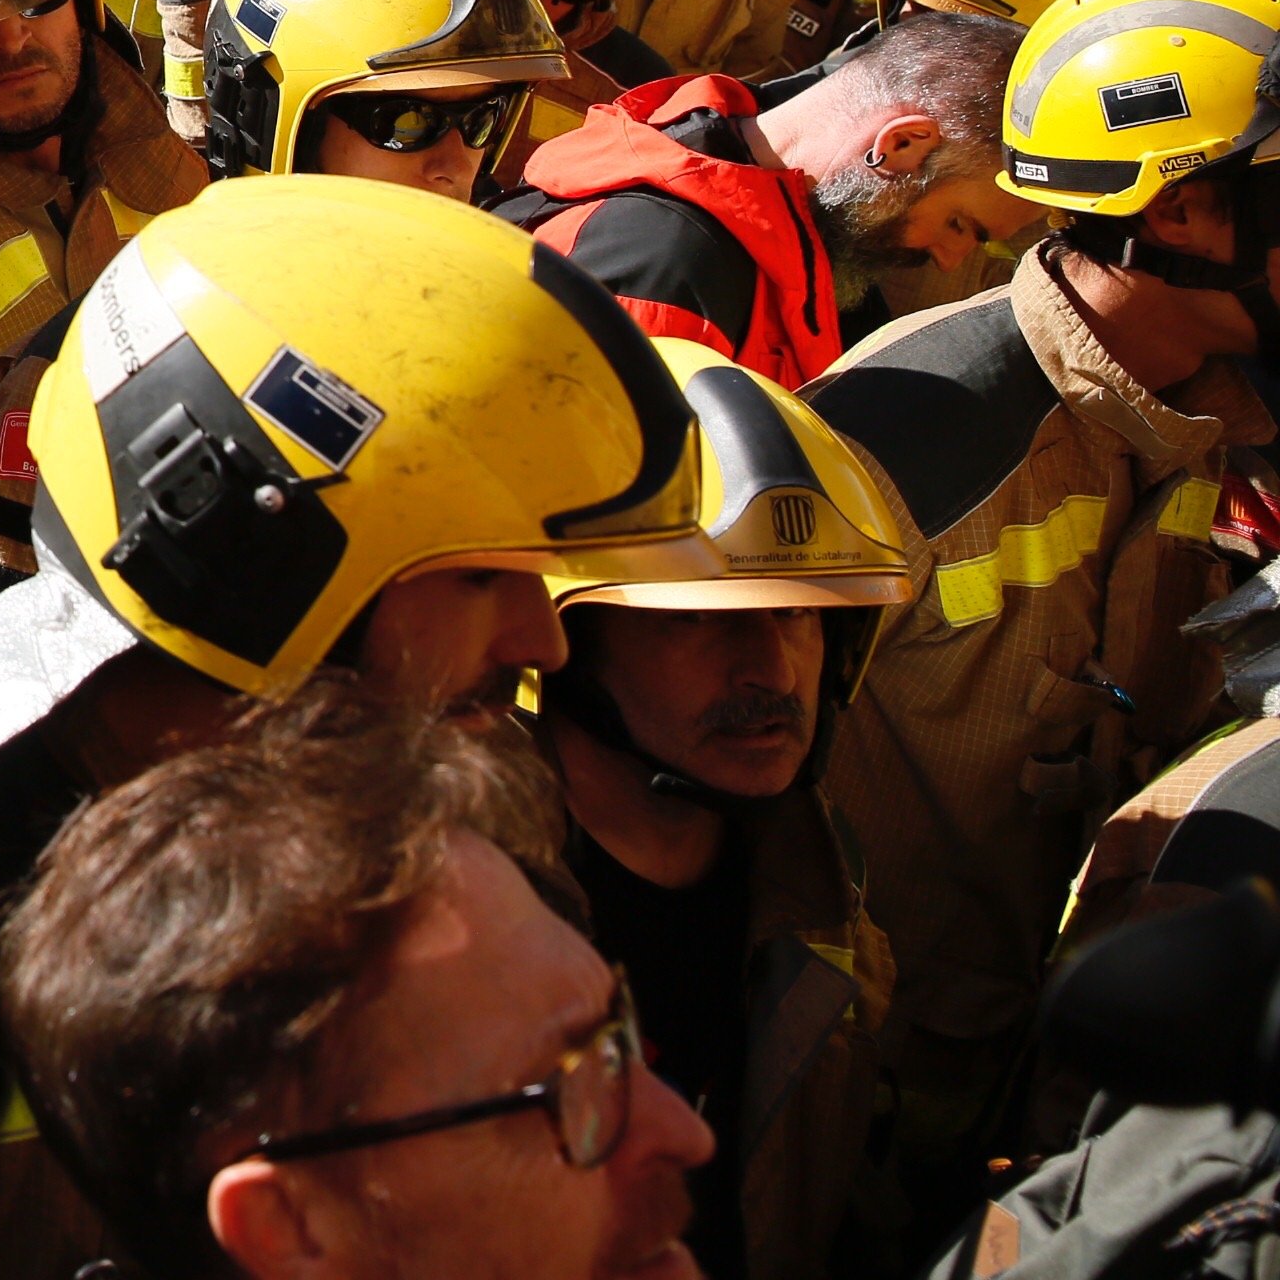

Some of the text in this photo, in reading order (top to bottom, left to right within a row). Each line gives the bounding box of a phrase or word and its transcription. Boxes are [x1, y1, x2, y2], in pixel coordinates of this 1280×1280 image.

[1131, 82, 1160, 95] BOMBER
[1161, 154, 1206, 172] MSA
[1015, 164, 1046, 178] MSA
[725, 549, 862, 565] Generalitat de Catalunya
